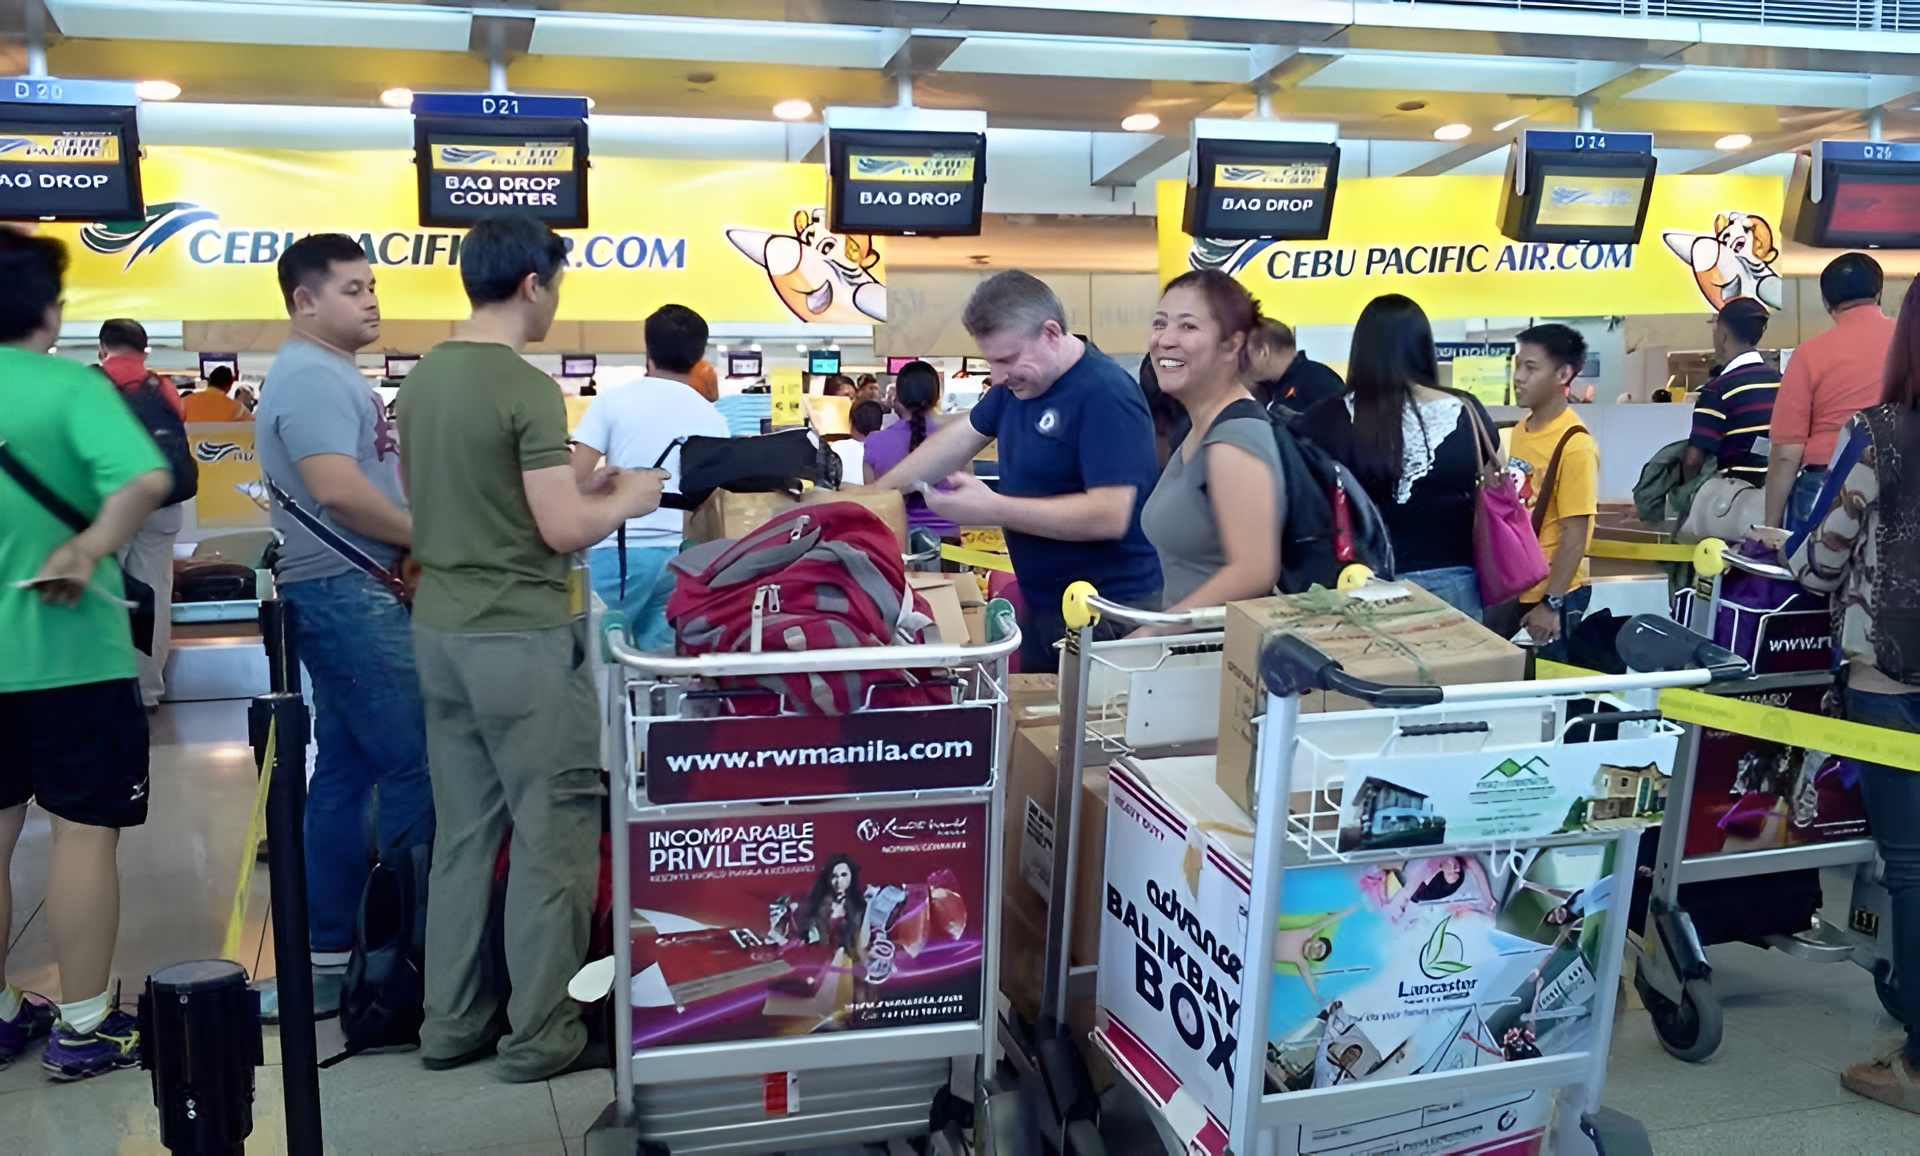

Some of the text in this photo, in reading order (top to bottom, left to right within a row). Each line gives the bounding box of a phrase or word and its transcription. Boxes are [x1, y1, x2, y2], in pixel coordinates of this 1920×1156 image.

[39, 174, 109, 189] DROP
[499, 177, 561, 191] DROP
[450, 192, 558, 206] COUNTER
[908, 192, 962, 206] DROP
[1265, 198, 1313, 212] DROP
[352, 231, 463, 266] ACIFI
[1267, 243, 1633, 280] CEBU PACIFIC AIR.COM
[666, 739, 974, 773] www.rwmanila.com
[649, 821, 814, 848] INCOMPARABLE
[649, 840, 815, 873] PRIVILEGES
[1146, 878, 1243, 985] advance
[1398, 978, 1478, 999] Lancaster
[1135, 941, 1238, 1091] BOX
